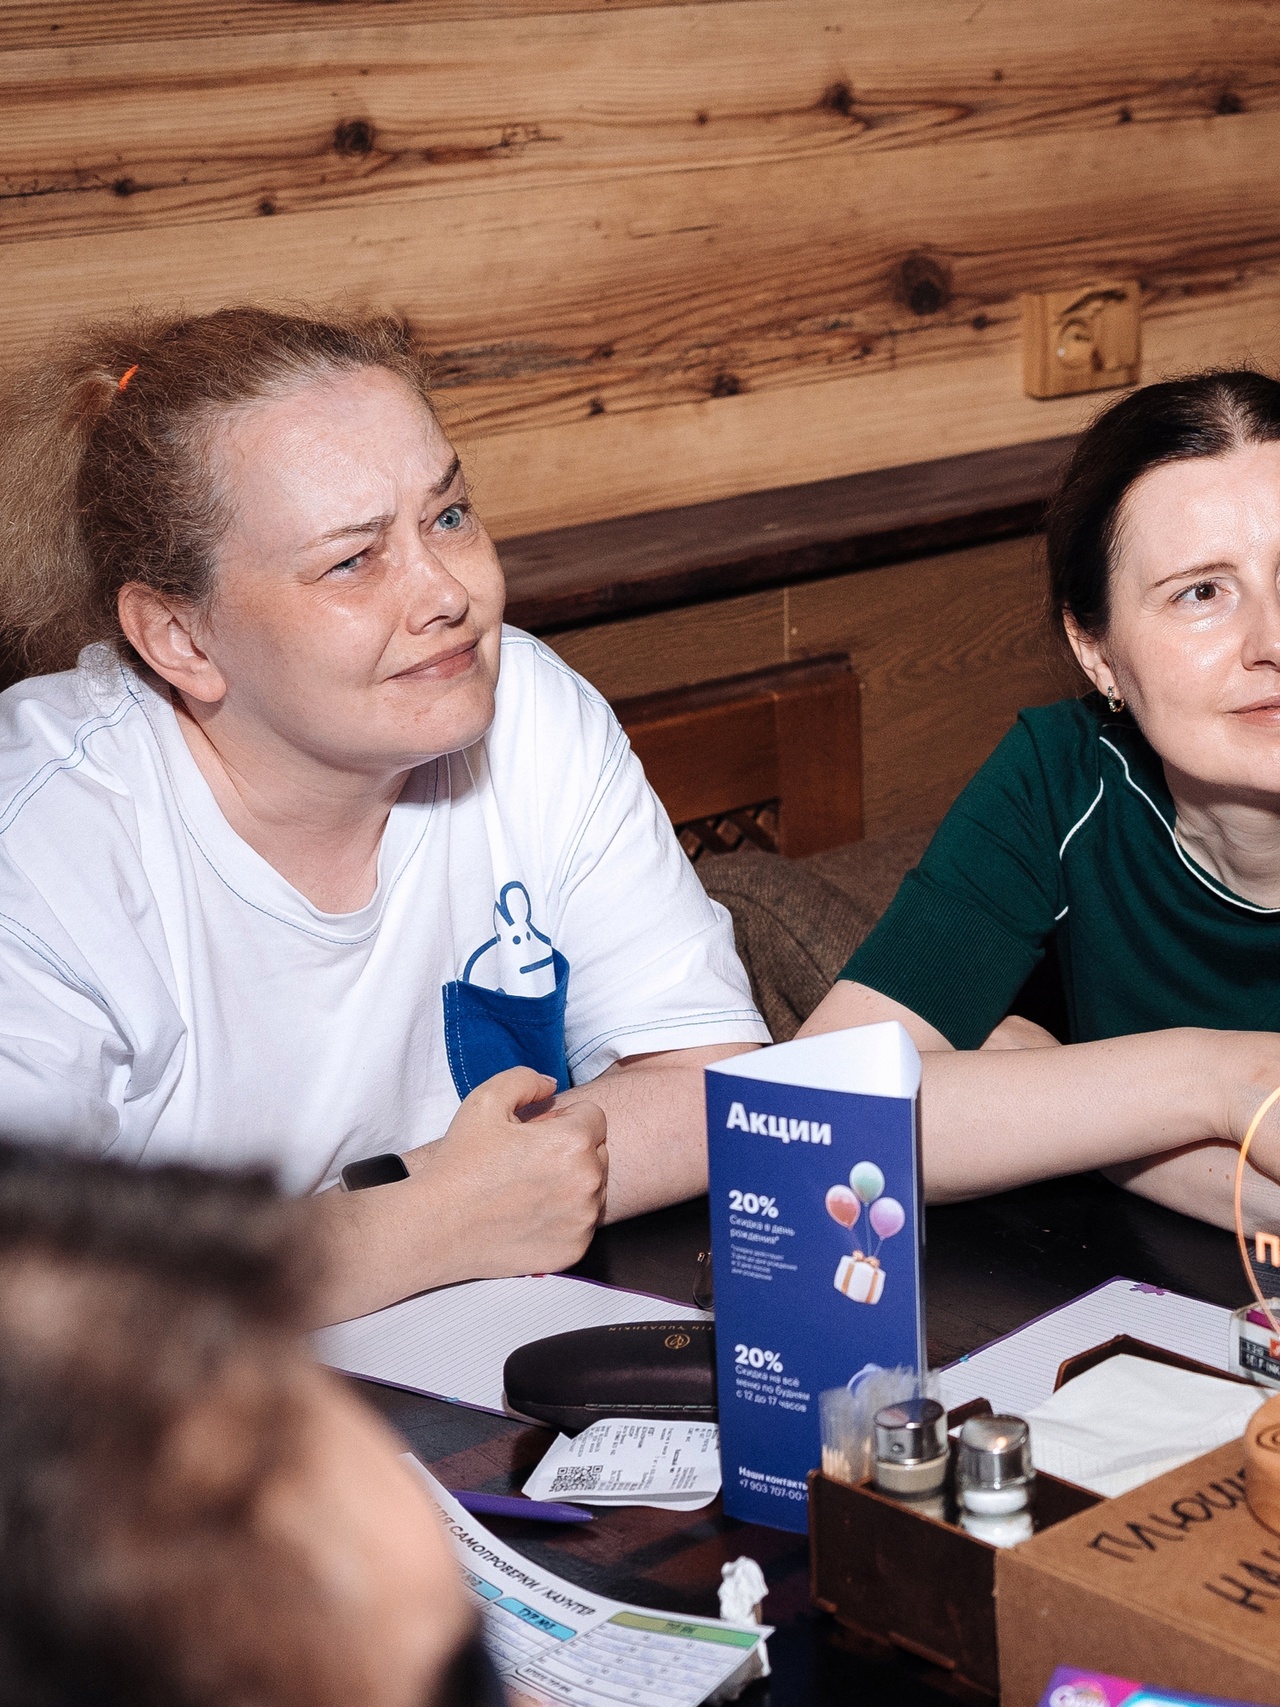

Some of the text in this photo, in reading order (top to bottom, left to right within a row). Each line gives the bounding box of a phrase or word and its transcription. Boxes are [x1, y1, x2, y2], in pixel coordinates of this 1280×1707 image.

[726, 1101, 832, 1146] Акции
[728, 1189, 779, 1219] 20%
[729, 1214, 796, 1237] Скидка в день
[734, 1344, 784, 1373] 20%
[735, 1364, 769, 1381] Скидка
[769, 1374, 782, 1385] на
[736, 1377, 811, 1402] меню по будням
[744, 1389, 754, 1402] 12
[754, 1395, 768, 1405] до
[768, 1396, 778, 1407] 17
[778, 1400, 807, 1413] часов
[739, 1466, 765, 1482] Наши
[749, 1481, 769, 1494] 903
[1087, 1468, 1246, 1564] ПЛЮШ
[450, 1525, 541, 1590] САМОПРОВЕРКИ
